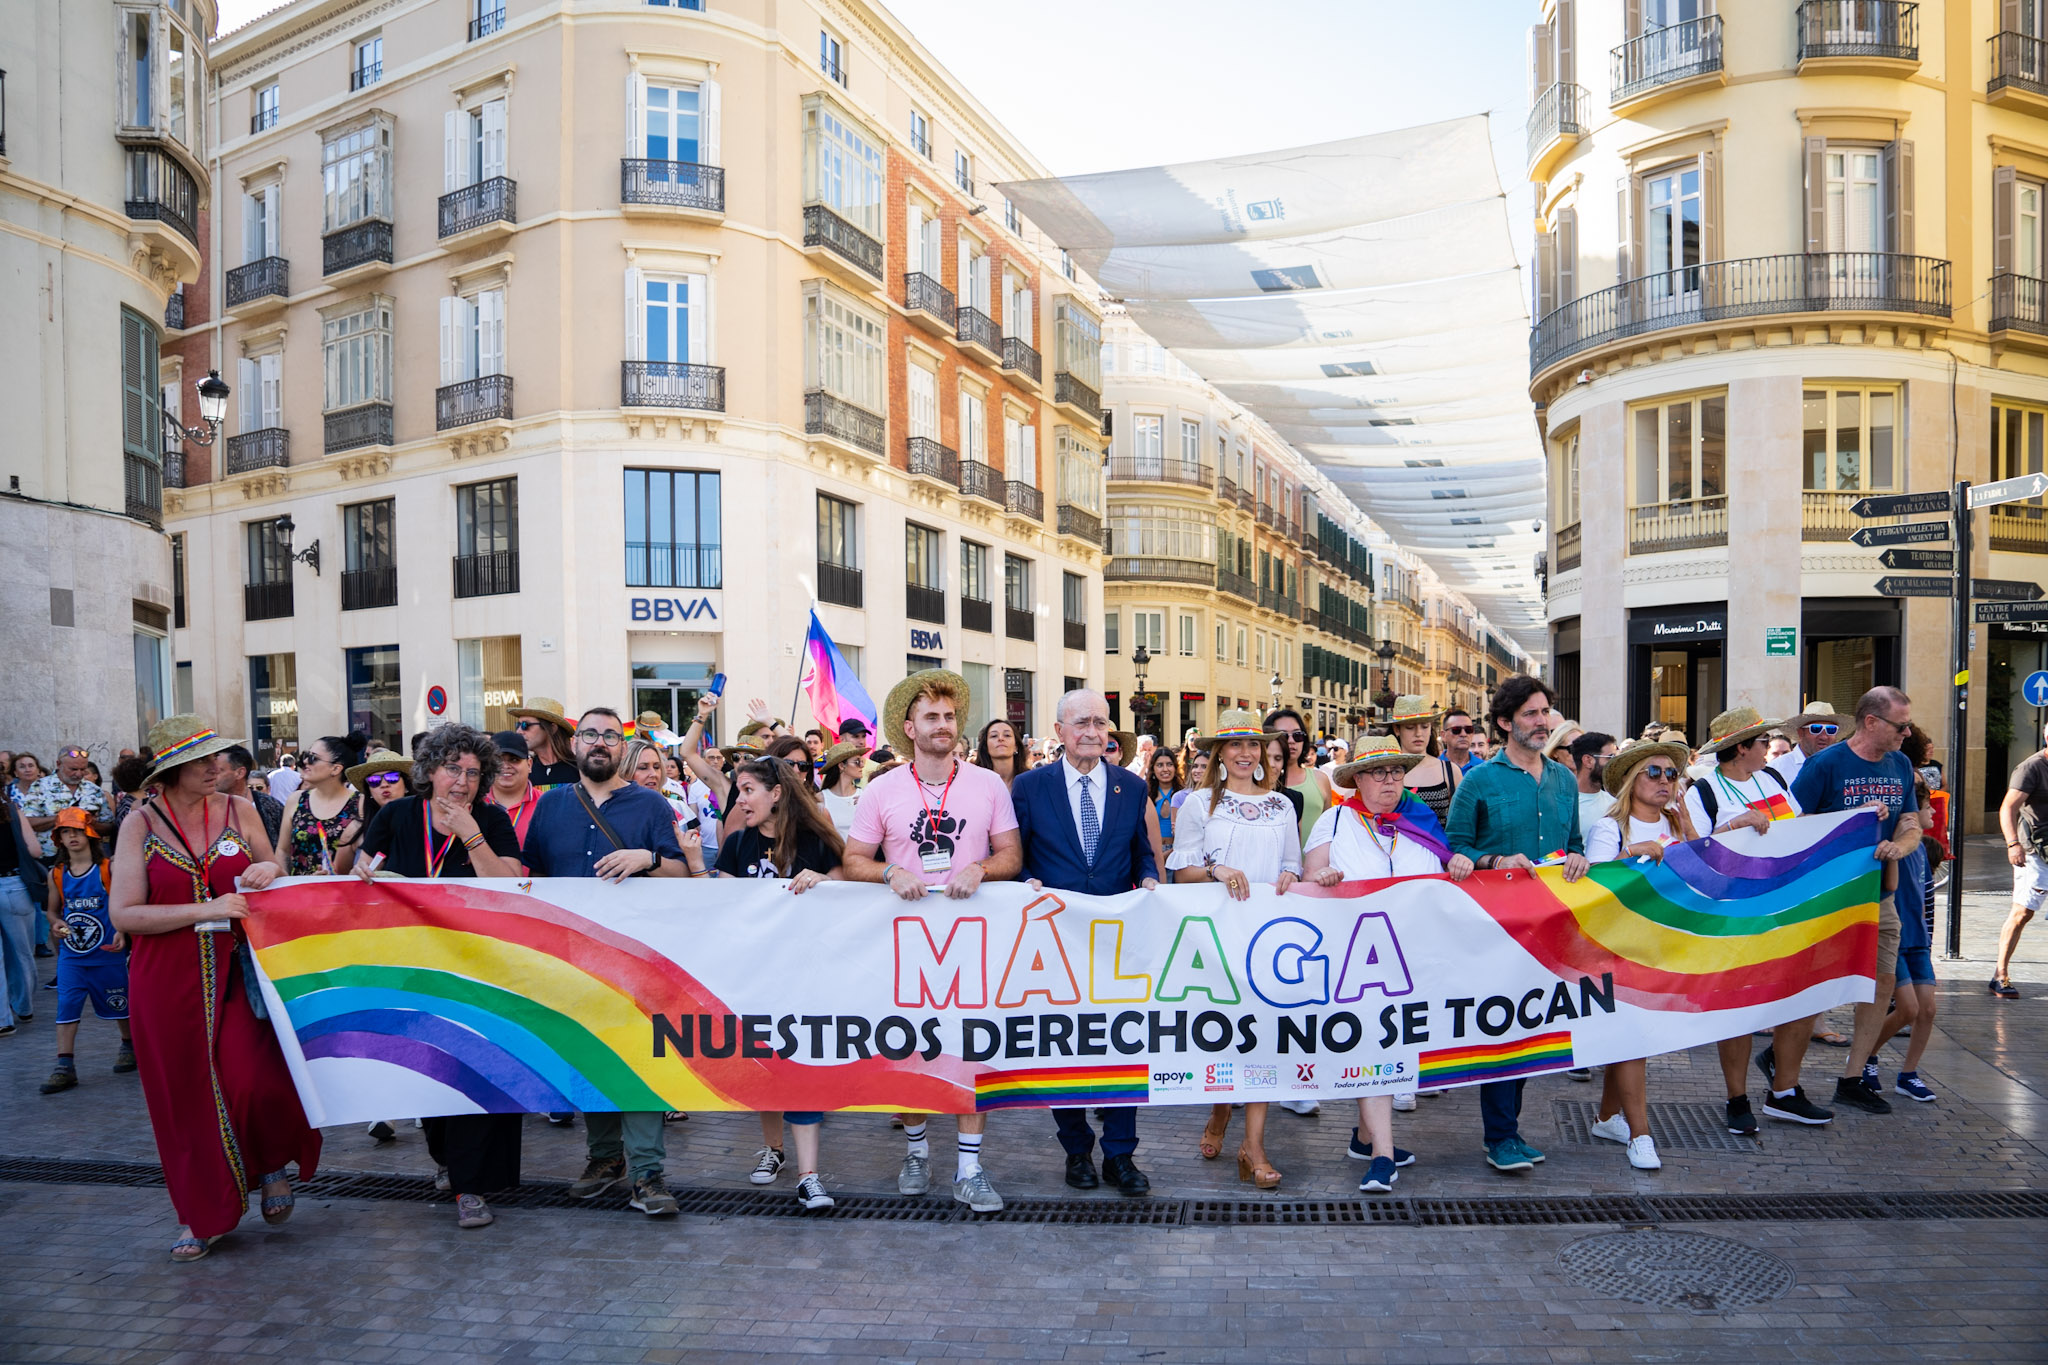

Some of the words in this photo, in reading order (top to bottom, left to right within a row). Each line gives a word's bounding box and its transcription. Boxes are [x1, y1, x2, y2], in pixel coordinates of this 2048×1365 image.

[1891, 501, 1947, 515] ATARAZANAS
[1876, 526, 1905, 537] IFERGAN
[1905, 523, 1946, 534] COLLECTION
[1907, 533, 1933, 542] ANCIENT
[1933, 532, 1946, 540] ART
[1910, 551, 1934, 561] TEATRO
[1934, 552, 1951, 561] SOHO
[631, 596, 718, 621] BBVA
[1978, 604, 2010, 613] CENTRE
[1978, 612, 2010, 622] MÁLAGA
[1653, 623, 1695, 636] Massimo
[1696, 620, 1722, 632] Dutti
[911, 628, 944, 650] BBVA
[484, 689, 520, 707] BBVA
[270, 698, 299, 715] BBVA
[1844, 777, 1866, 785] PASS
[1844, 795, 1860, 806] OF
[1863, 795, 1903, 805] OTHERS
[909, 808, 928, 845] give
[893, 893, 1414, 1010] MÁLAGA
[651, 1012, 943, 1062] NUESTROS
[962, 1009, 1258, 1062] DERECHOS
[1277, 1011, 1363, 1055] NO
[1379, 1001, 1430, 1050] SE
[1445, 971, 1617, 1040] TOCAN
[1341, 1061, 1405, 1079] JUNT@S
[1333, 1081, 1356, 1089] Todos
[1356, 1080, 1370, 1089] por
[1380, 1075, 1414, 1087] igualdad
